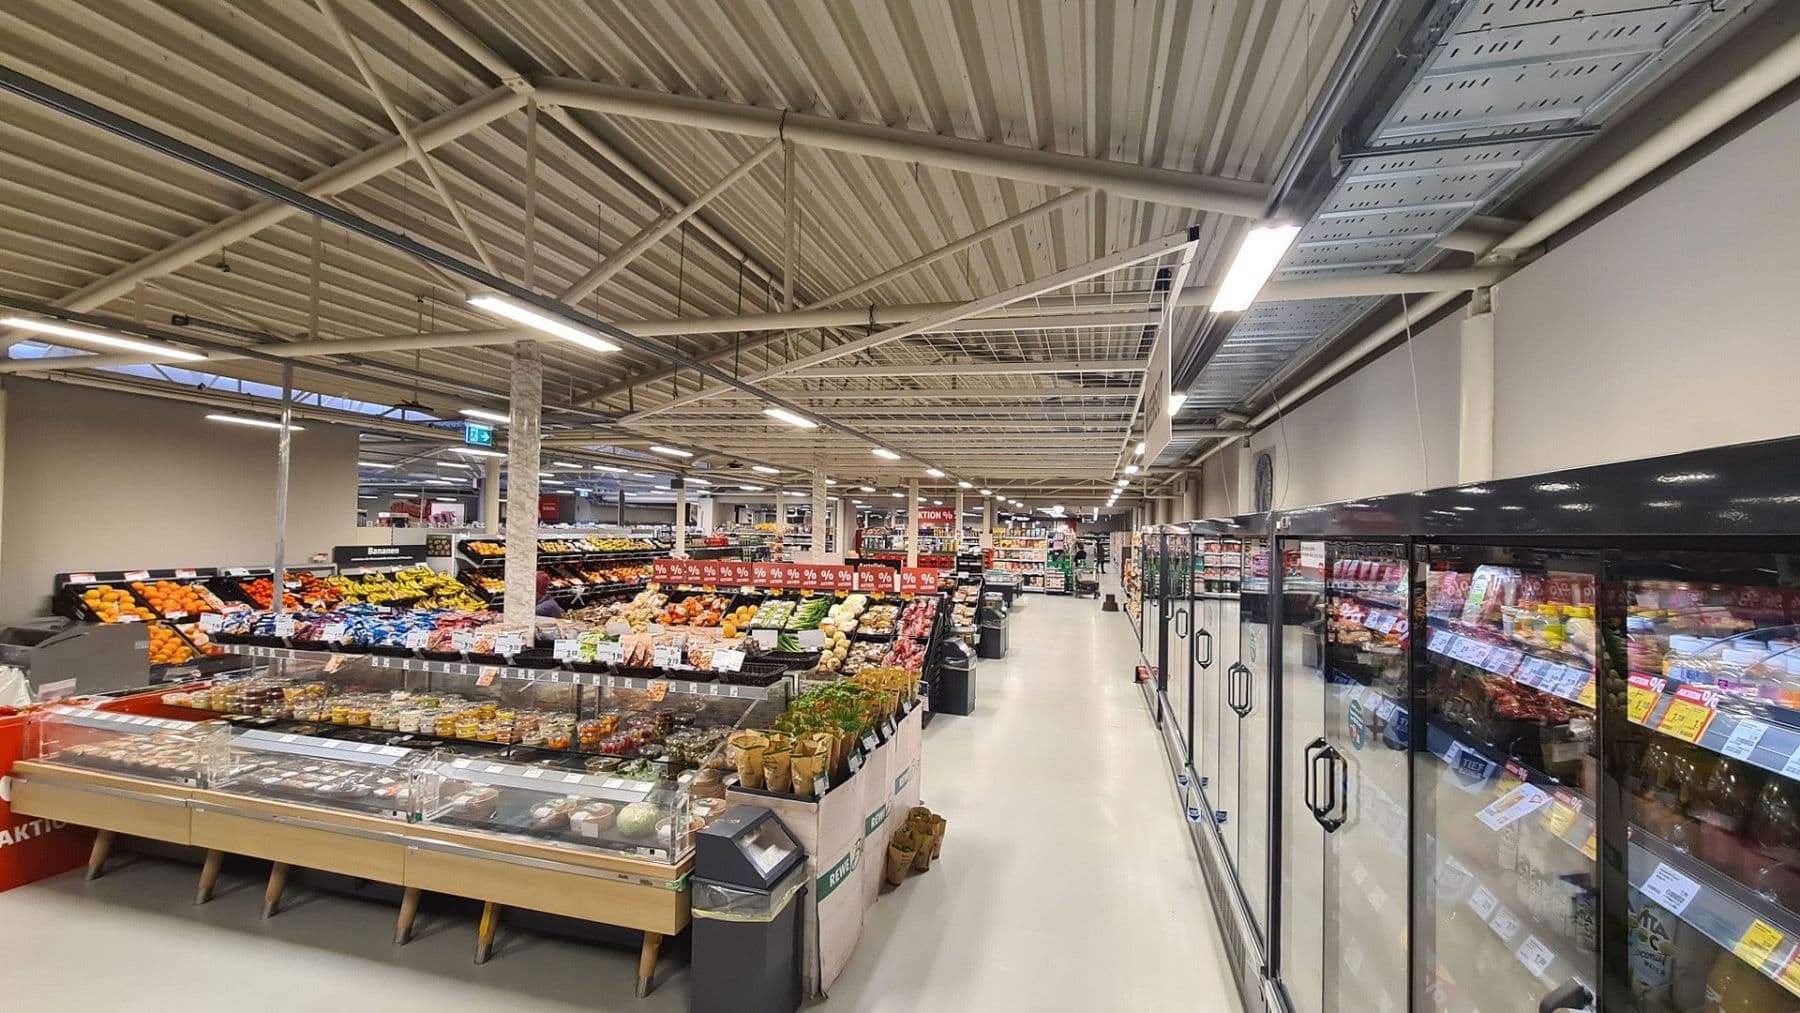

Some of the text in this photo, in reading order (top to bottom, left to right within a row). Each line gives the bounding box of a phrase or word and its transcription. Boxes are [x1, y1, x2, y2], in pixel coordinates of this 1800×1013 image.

[918, 511, 941, 519] KTION
[368, 547, 399, 555] Bananen
[754, 568, 851, 581] % % % % % %
[861, 572, 892, 583] % %
[903, 573, 934, 584] % %
[1463, 759, 1485, 772] TIEF
[829, 859, 850, 888] REWE
